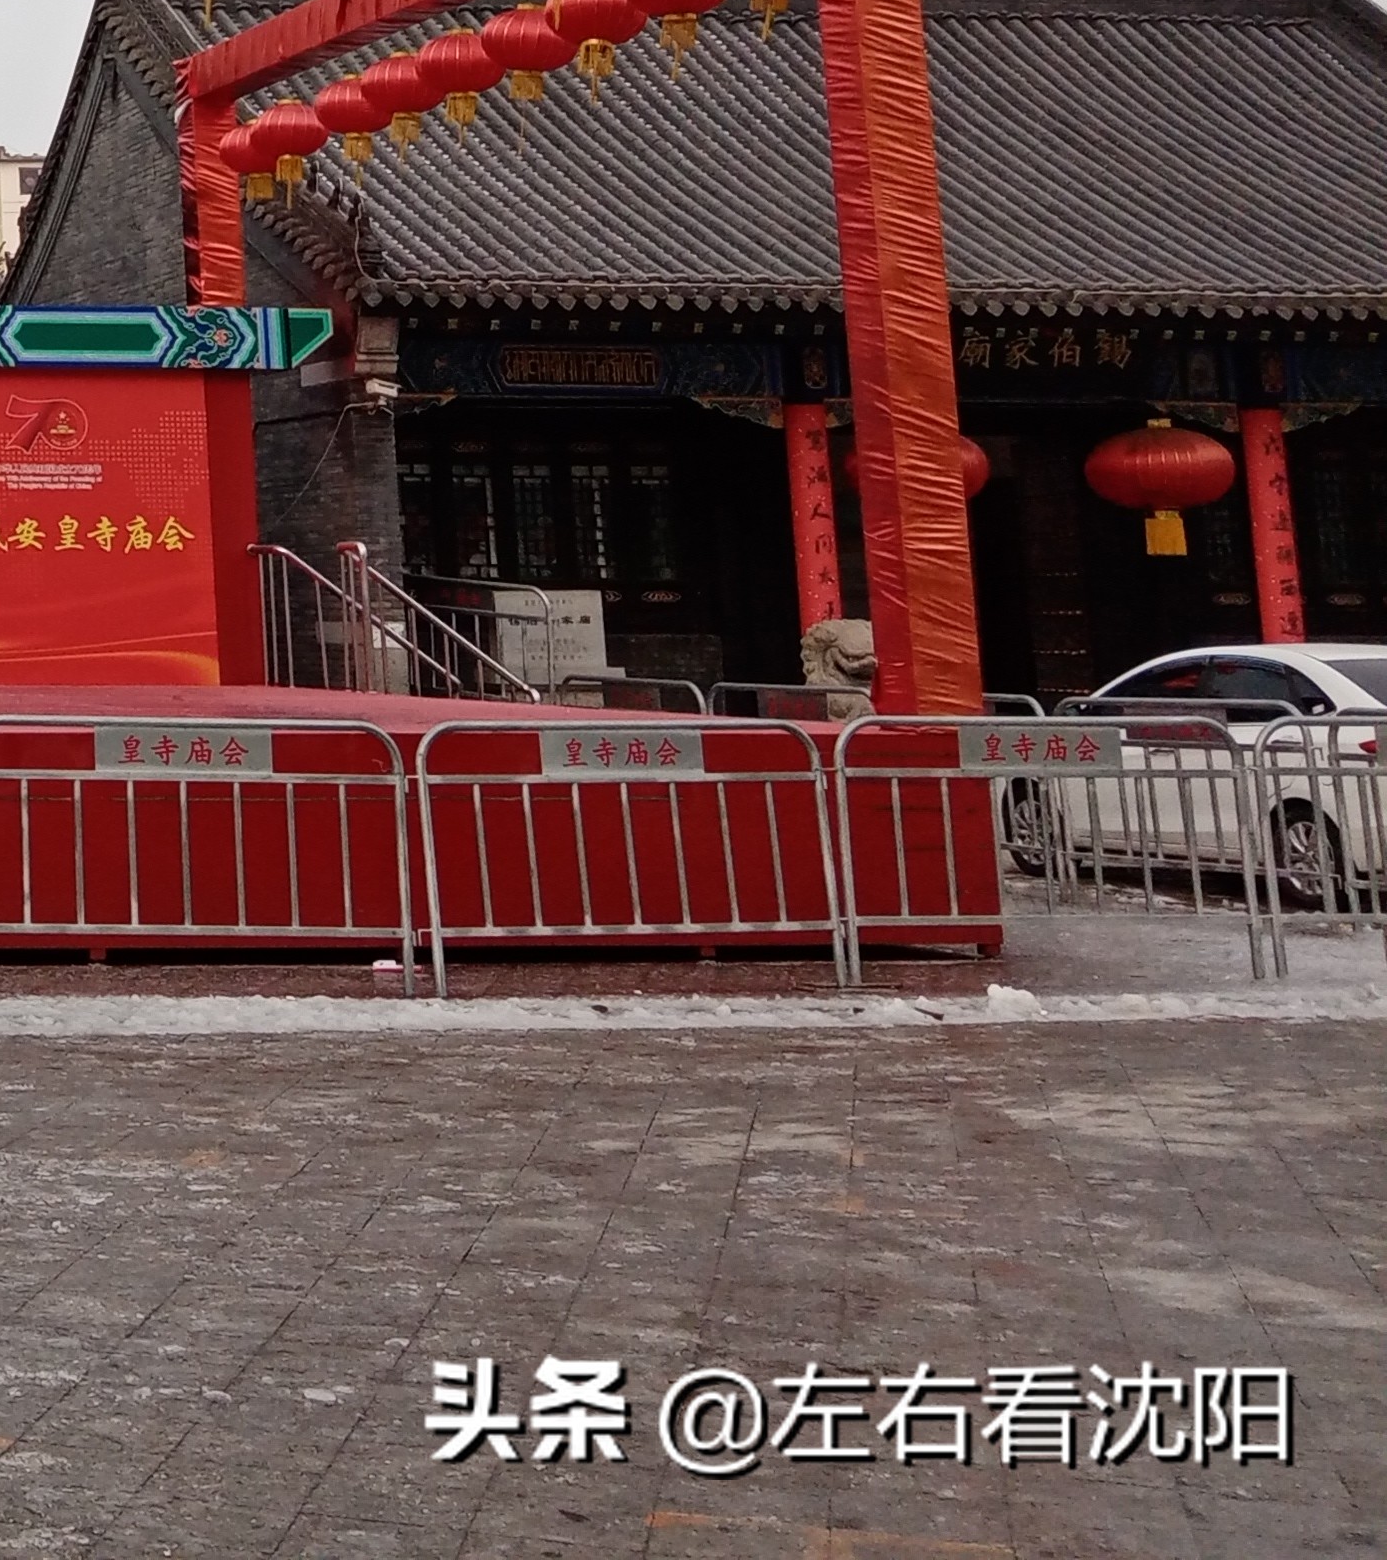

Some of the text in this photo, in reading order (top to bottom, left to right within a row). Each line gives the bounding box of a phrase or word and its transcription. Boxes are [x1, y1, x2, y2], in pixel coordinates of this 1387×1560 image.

[118, 735, 249, 766] 皇寺庙会
[564, 738, 682, 768] 皇寺庙会
[981, 734, 1101, 763] 皇寺庙会
